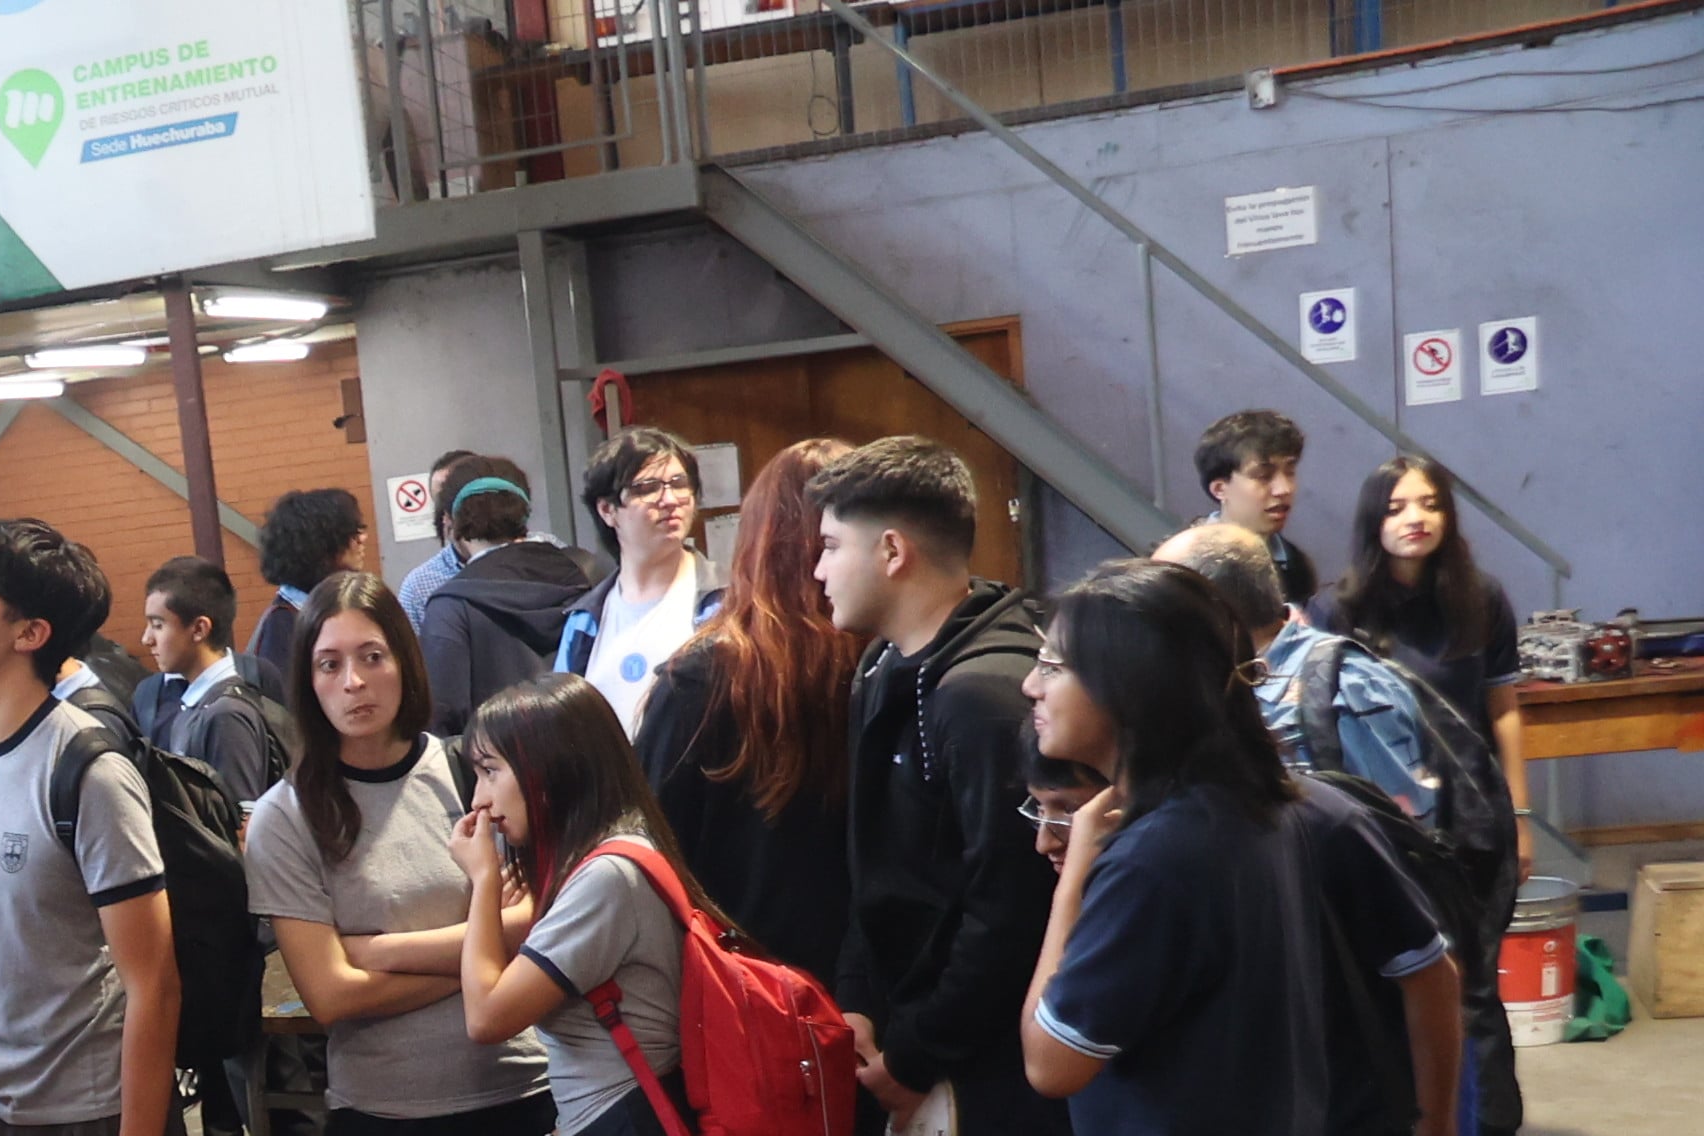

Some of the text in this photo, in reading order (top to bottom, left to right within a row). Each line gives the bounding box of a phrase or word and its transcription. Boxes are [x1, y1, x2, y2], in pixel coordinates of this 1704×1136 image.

[73, 40, 210, 83] CAMPUS DE
[75, 55, 279, 110] ENTRENAMIENTO
[78, 119, 97, 132] DE
[99, 104, 157, 127] RIESGOS
[223, 82, 280, 105] MUTUAL
[90, 119, 227, 158] Sede Huechuraba
